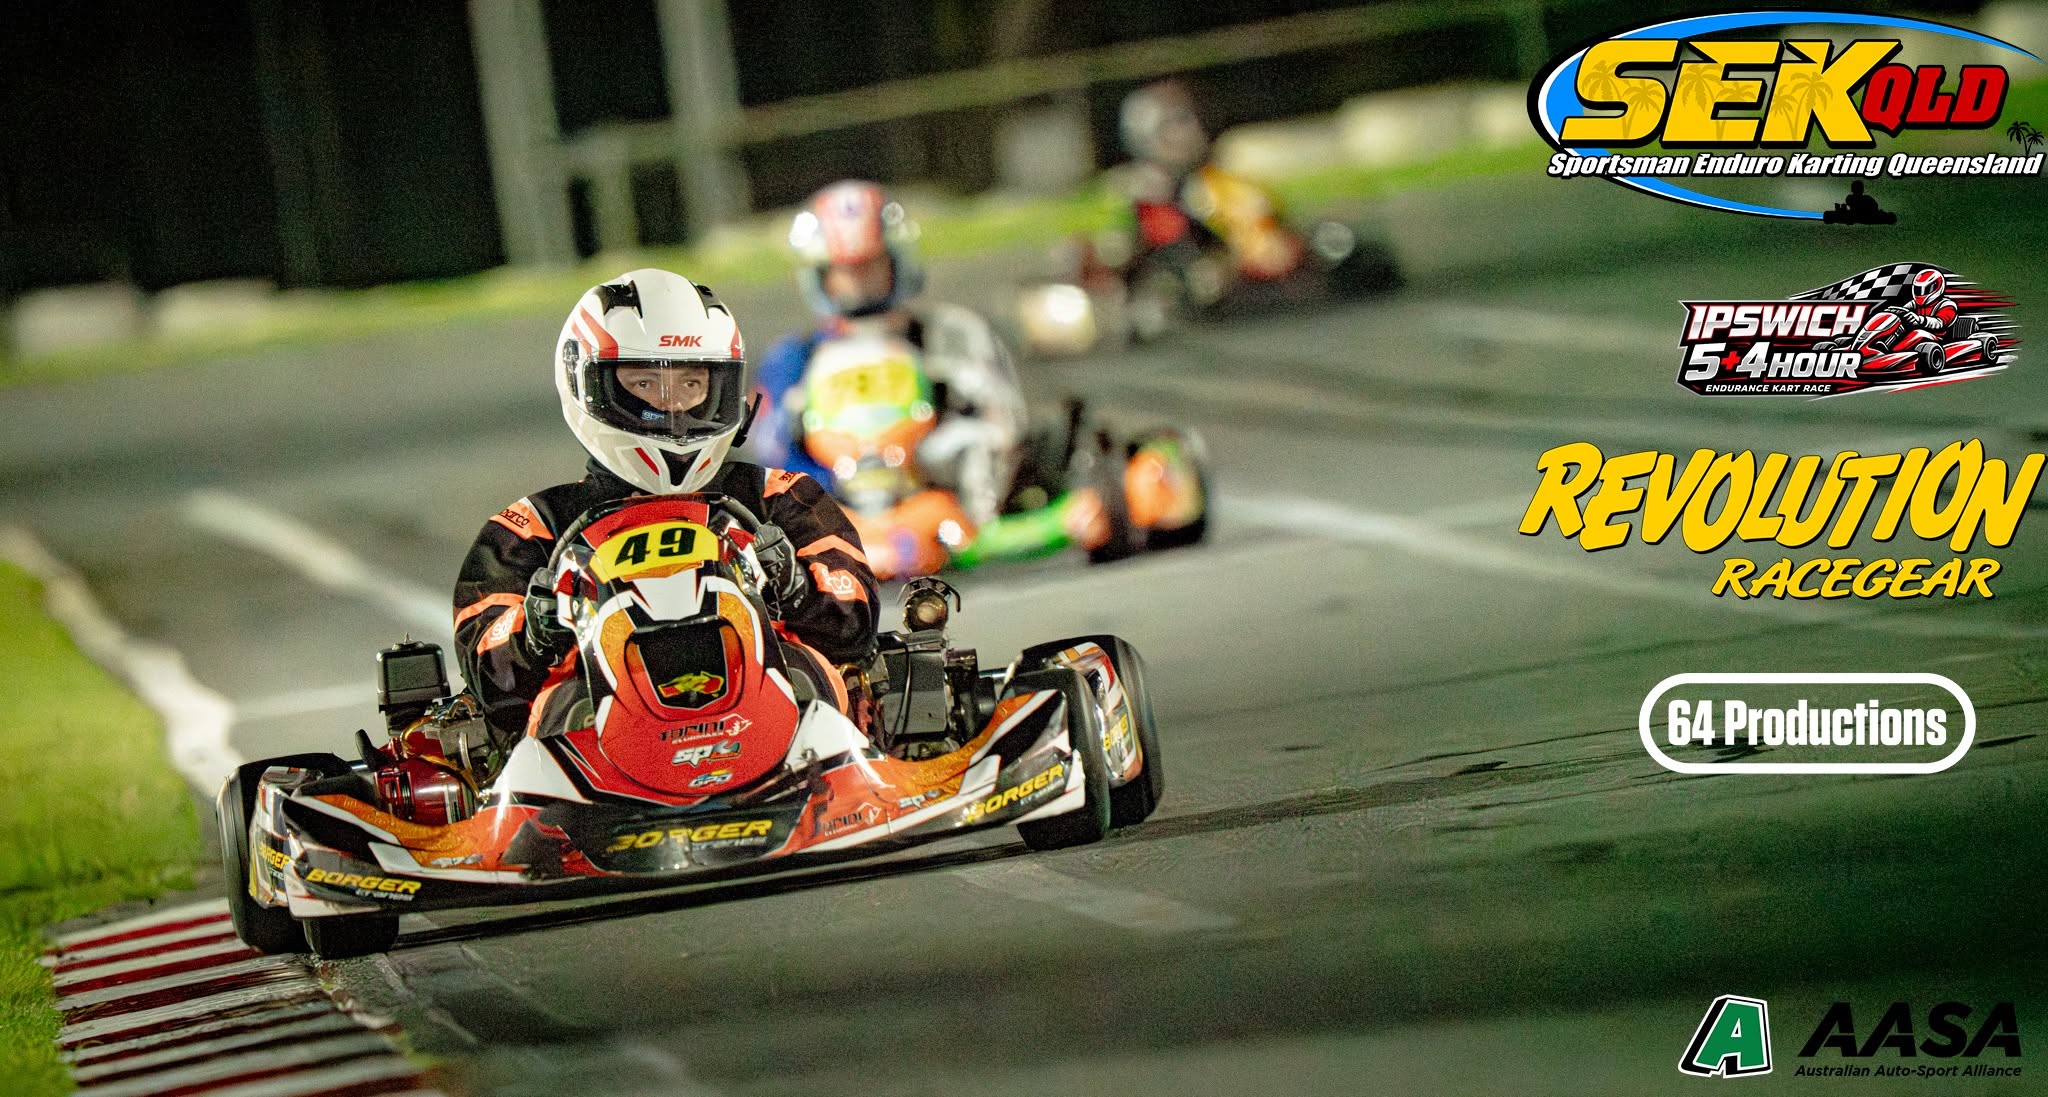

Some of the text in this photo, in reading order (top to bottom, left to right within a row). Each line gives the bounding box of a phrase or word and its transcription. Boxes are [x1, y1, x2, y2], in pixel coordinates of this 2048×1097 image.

[658, 335, 702, 348] SMK
[614, 527, 698, 566] 49
[305, 867, 422, 895] BORGER
